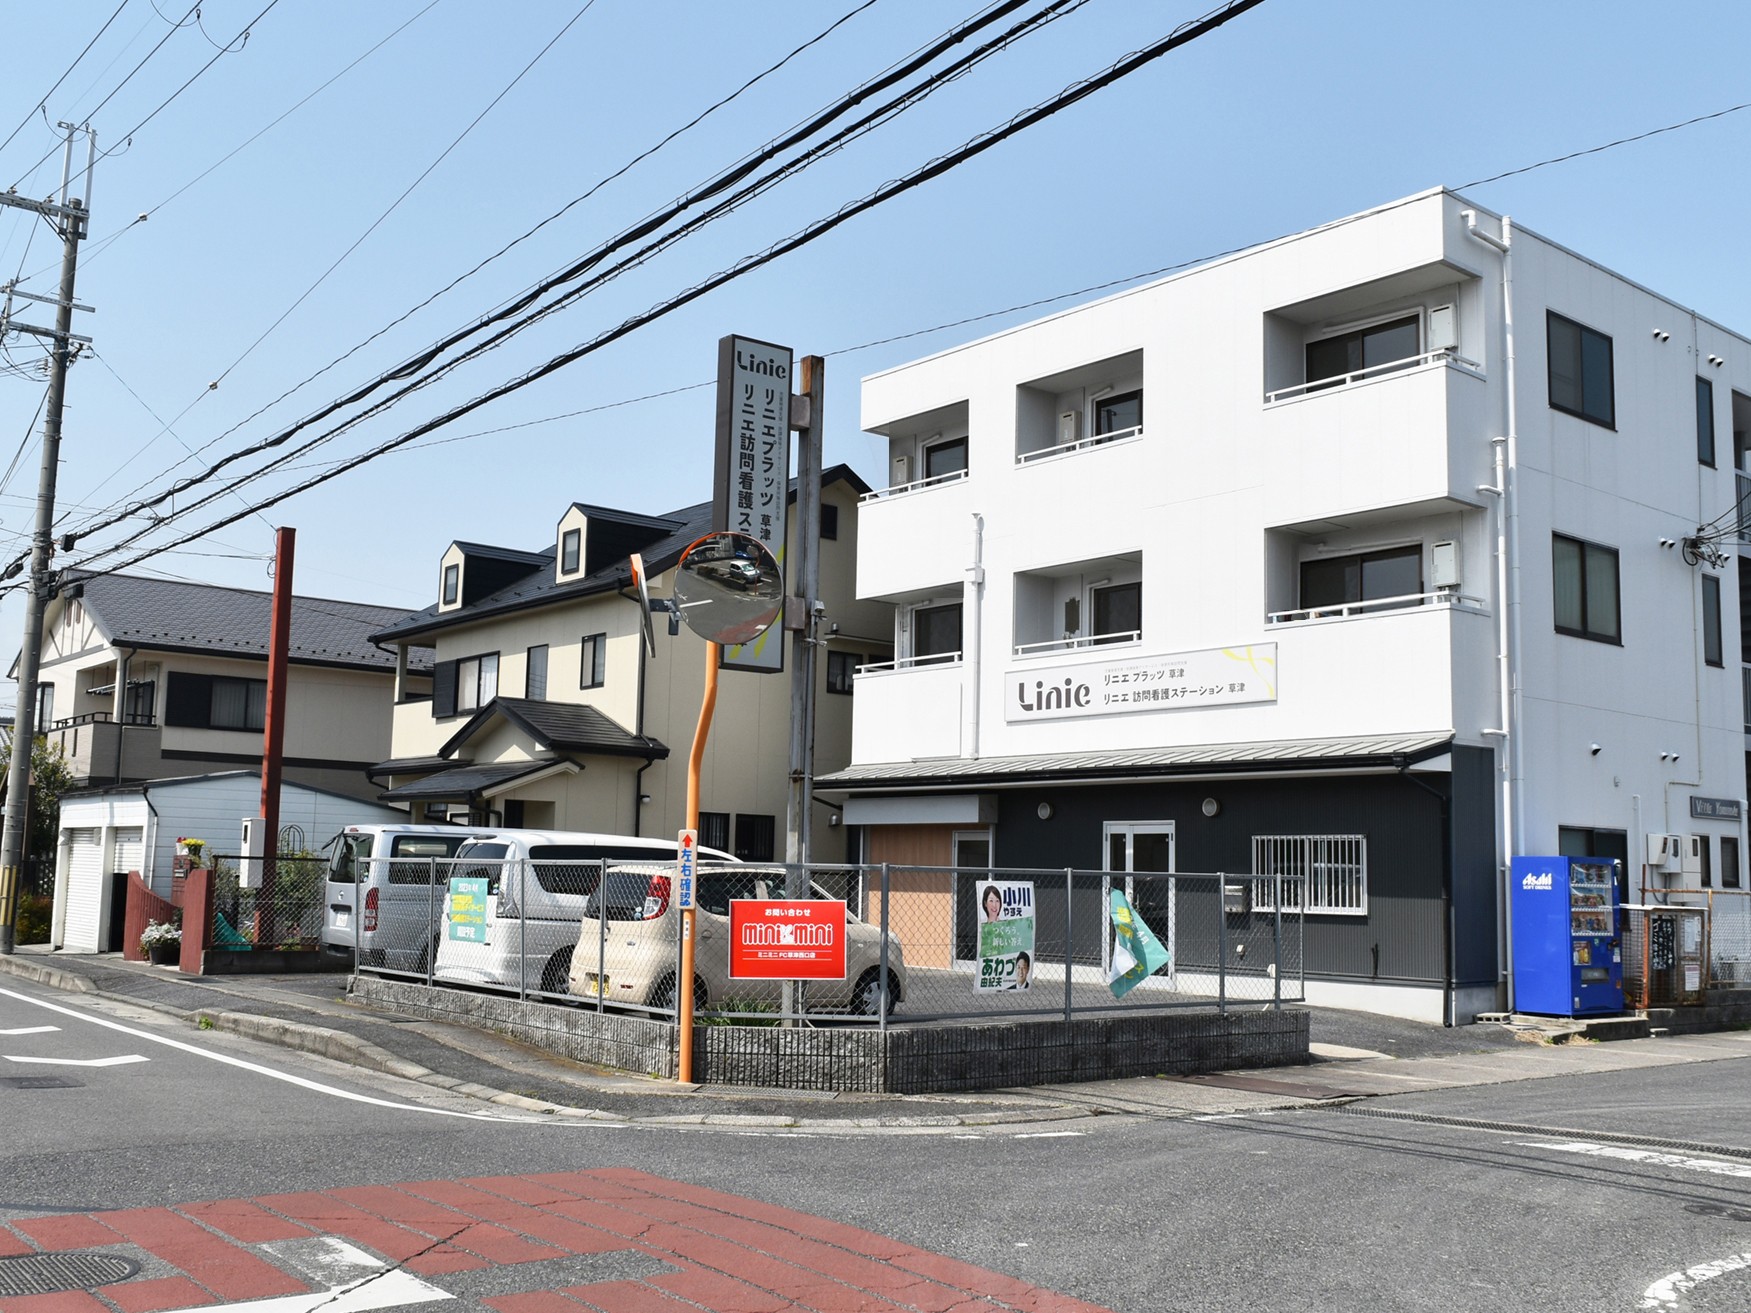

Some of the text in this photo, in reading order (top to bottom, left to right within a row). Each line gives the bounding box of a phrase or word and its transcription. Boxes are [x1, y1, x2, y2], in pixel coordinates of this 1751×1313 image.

[737, 350, 787, 380] Linie
[760, 514, 772, 541] 草津
[1104, 674, 1130, 686] リニエ
[1168, 668, 1185, 679] 草津
[1018, 677, 1091, 712] Linie
[1104, 682, 1246, 705] リニエ 訪問看護ステーション 草津
[679, 848, 692, 907] 左右確認
[1522, 872, 1552, 885] Asahi
[1003, 887, 1031, 907] 小川
[765, 908, 811, 917] お問い合わせ
[1003, 907, 1023, 917] やすえ
[793, 923, 833, 946] mini
[981, 958, 1015, 977] あわづ
